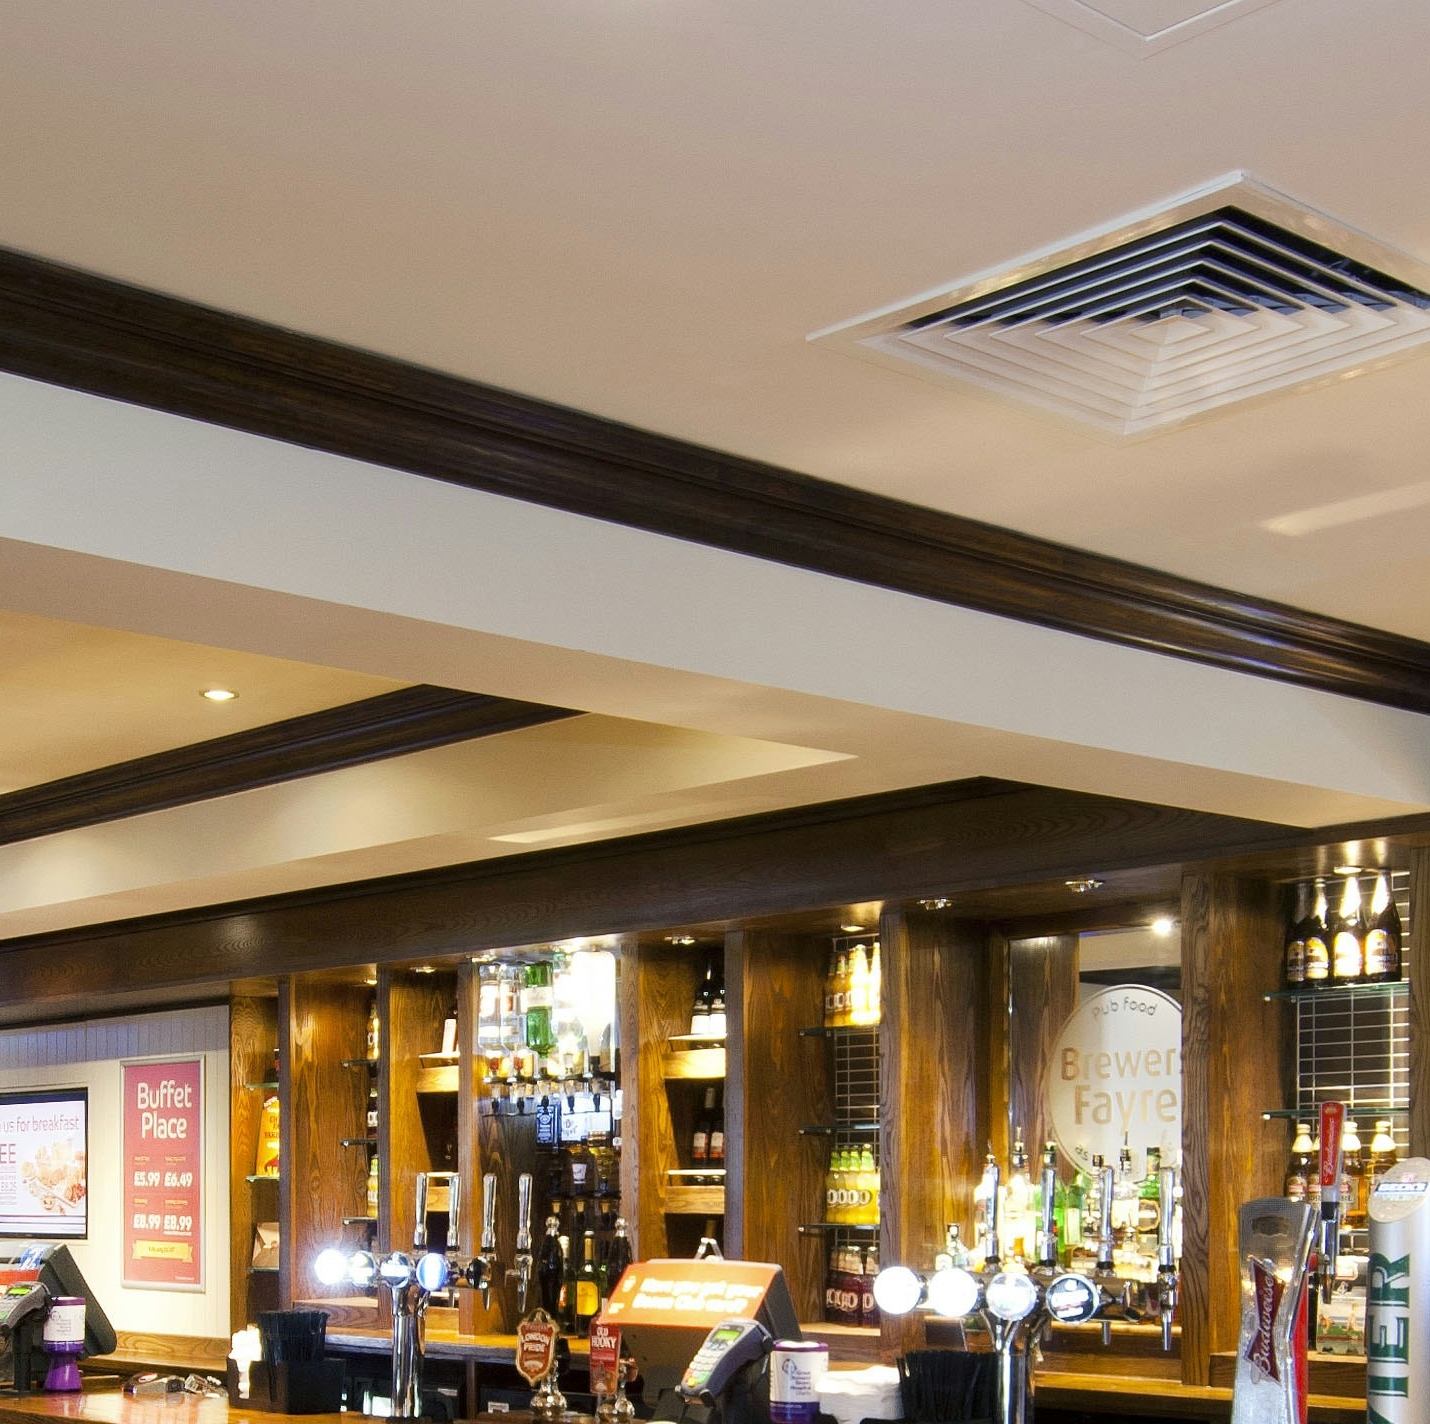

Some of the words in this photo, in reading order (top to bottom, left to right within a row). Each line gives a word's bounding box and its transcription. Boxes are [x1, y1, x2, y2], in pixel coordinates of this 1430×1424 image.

[1093, 1000, 1120, 1020] pub
[1124, 995, 1158, 1017] food
[1061, 1047, 1177, 1081] Brewer
[137, 1079, 192, 1110] Buffet
[3, 1121, 14, 1133] us
[16, 1116, 31, 1132] for
[32, 1113, 80, 1131] breakfast
[1074, 1084, 1178, 1137] Fayre
[141, 1111, 188, 1139] Place
[134, 1171, 160, 1187] £5.99
[164, 1172, 193, 1188] £6.49
[133, 1213, 161, 1230] £8.99
[164, 1214, 193, 1231] £8.99
[597, 1327, 609, 1337] OLD
[1253, 1272, 1275, 1374] Budweise
